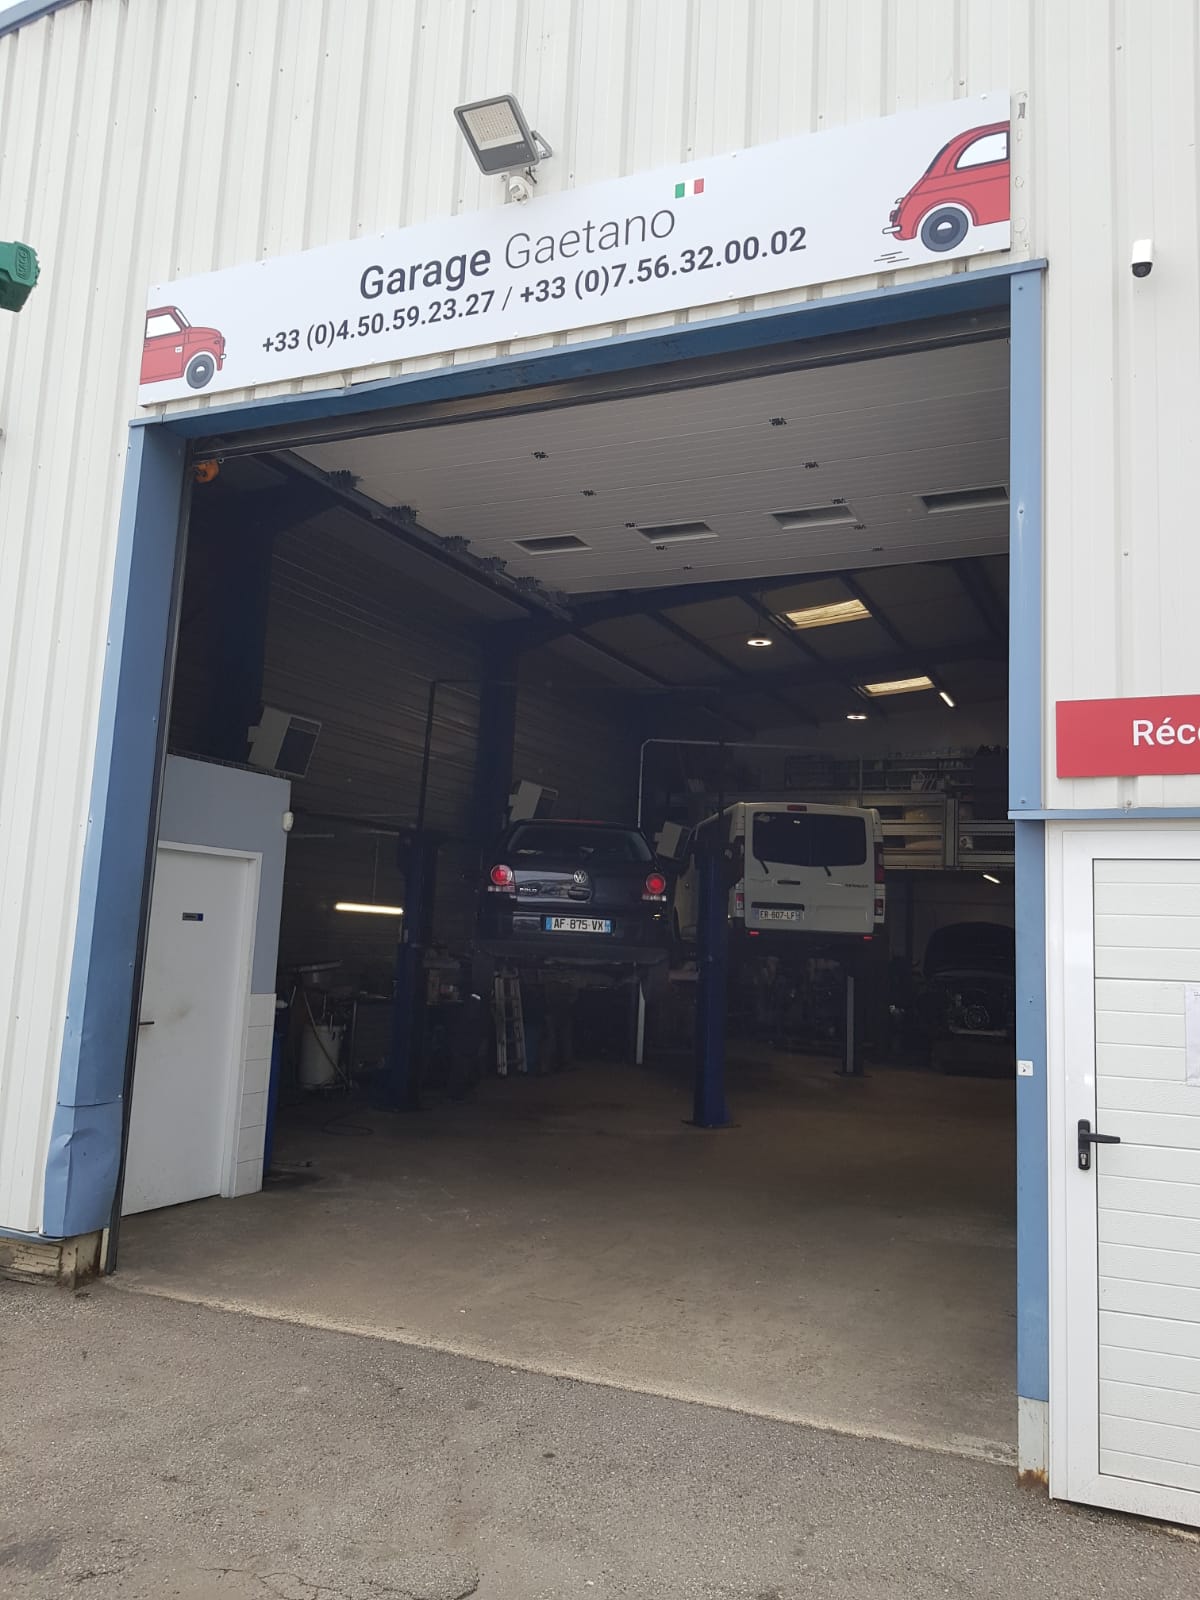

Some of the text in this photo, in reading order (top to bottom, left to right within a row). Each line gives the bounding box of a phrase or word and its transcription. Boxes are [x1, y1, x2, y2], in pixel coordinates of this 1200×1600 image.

[262, 226, 807, 353] +33 (0)4.50.59.23.27 / +33 (0)7.56.32.00.02
[360, 209, 675, 300] Garage Gaetano
[1132, 716, 1200, 747] Réc
